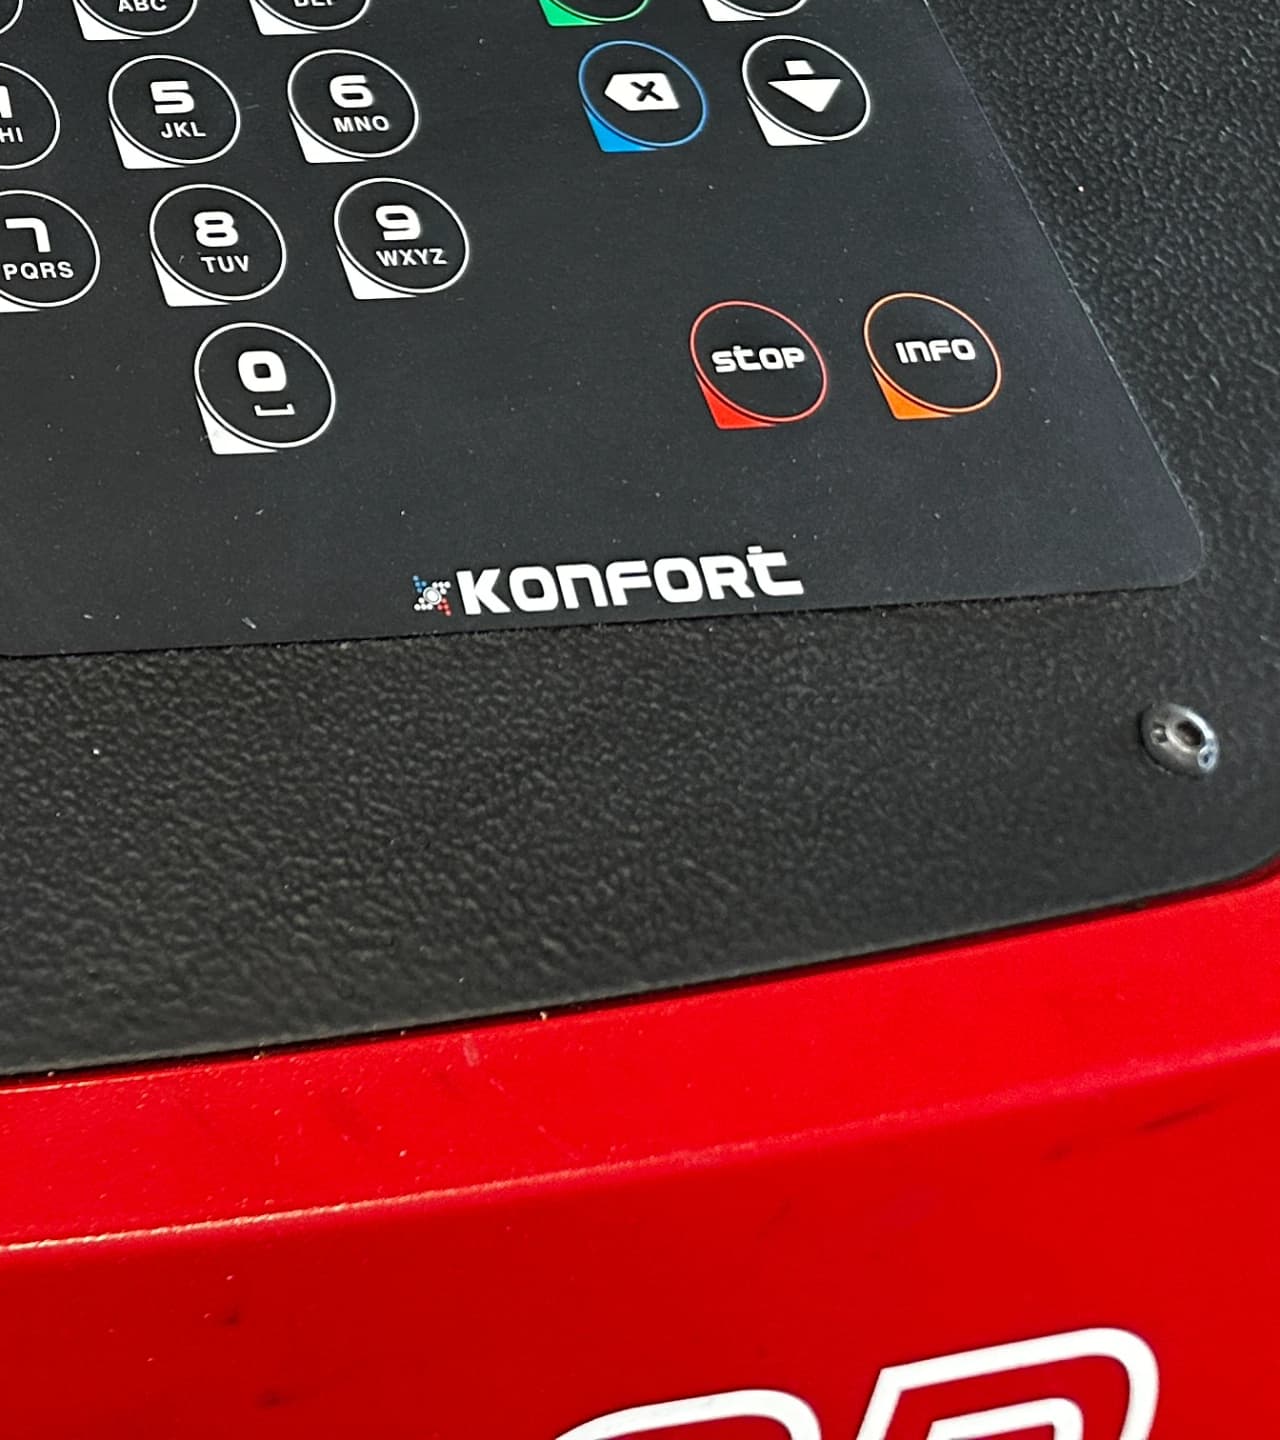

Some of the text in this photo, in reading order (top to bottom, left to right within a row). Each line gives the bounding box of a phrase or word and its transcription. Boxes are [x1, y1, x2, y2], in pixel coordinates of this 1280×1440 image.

[150, 80, 195, 114] 5
[329, 74, 374, 109] 6
[159, 121, 207, 139] JKL
[332, 114, 390, 133] MNO
[5, 217, 51, 253] 7
[193, 211, 239, 248] 8
[375, 204, 422, 241] 9
[2, 260, 75, 281] PQRS
[200, 254, 250, 274] TUV
[375, 248, 448, 267] WXYZ
[895, 337, 977, 365] INFO
[238, 350, 288, 394] 0
